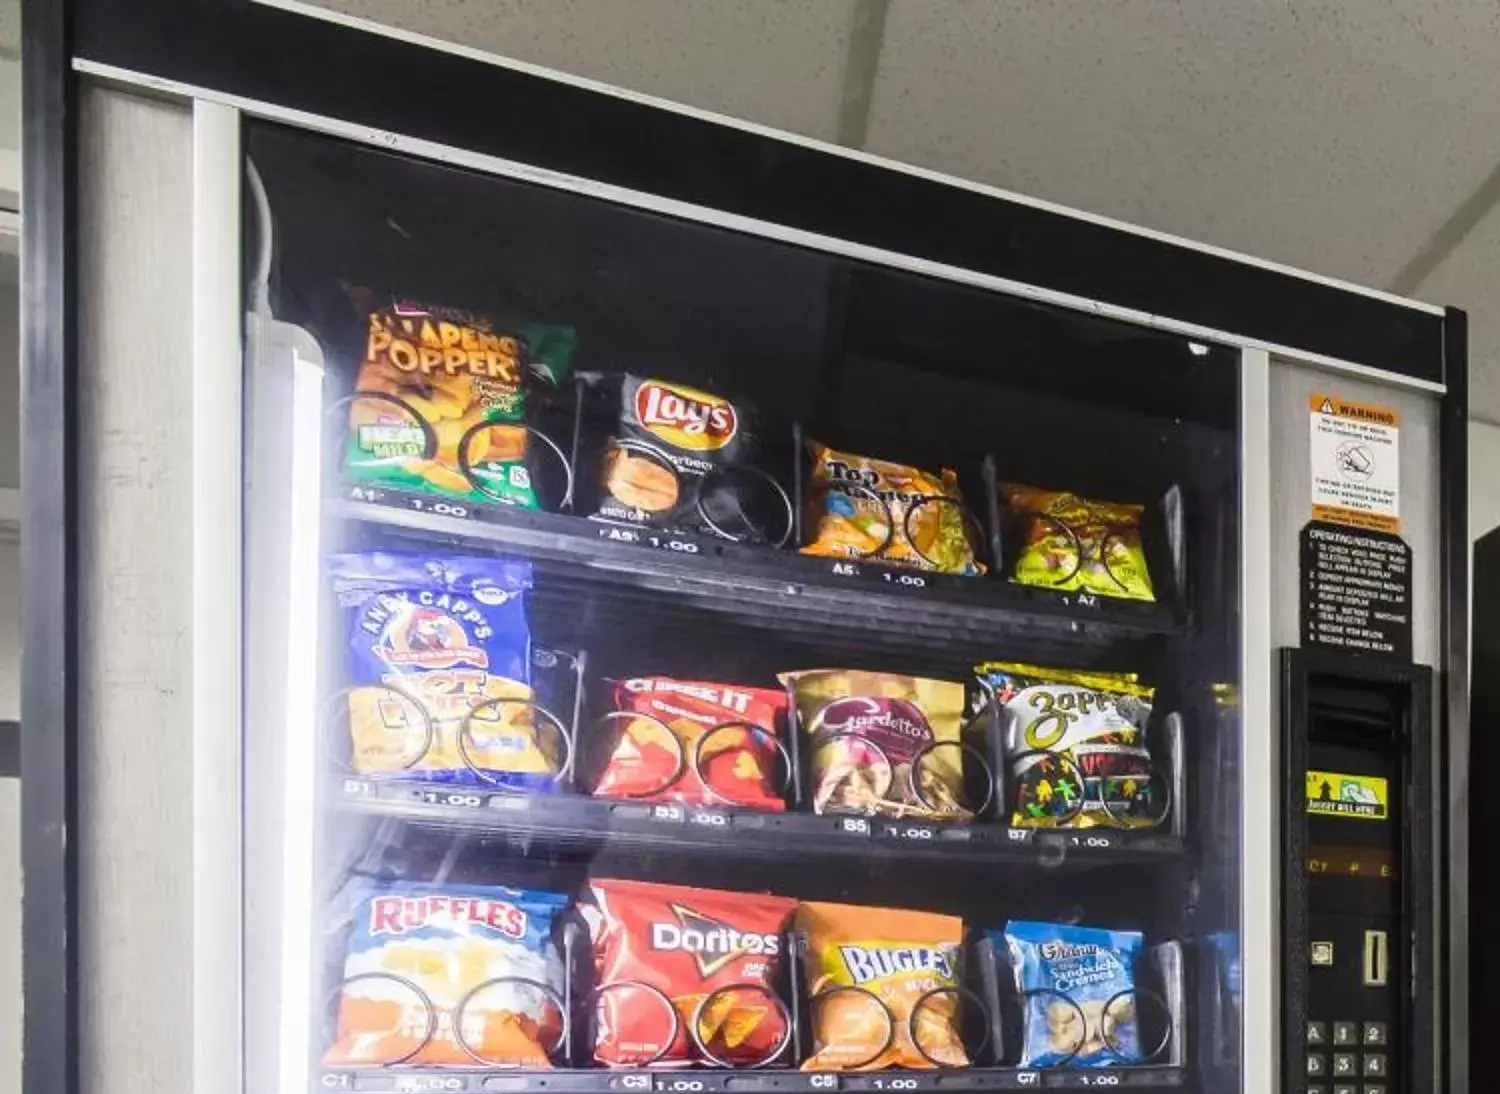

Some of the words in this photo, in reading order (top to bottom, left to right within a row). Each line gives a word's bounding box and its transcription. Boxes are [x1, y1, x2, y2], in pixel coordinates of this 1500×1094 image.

[644, 387, 729, 434] Lay's
[1339, 405, 1394, 424] WARNING
[827, 461, 879, 490] Top
[411, 499, 467, 519] 1.00
[650, 537, 699, 554] 1.00
[883, 573, 926, 588] 1.00
[424, 792, 482, 809] 1.00
[886, 827, 933, 840] 1.00
[1072, 836, 1110, 849] 1.00
[370, 895, 528, 940] RUFFLES
[652, 923, 780, 956] Doritos
[1307, 1026, 1321, 1041] A
[1339, 1026, 1348, 1041] 1
[1368, 1026, 1380, 1042] 2
[1307, 1057, 1320, 1072] B
[1338, 1057, 1349, 1072] 3
[622, 1076, 648, 1089] C3
[655, 1080, 704, 1092] 1.00
[873, 1080, 919, 1090] 1.00
[1080, 1075, 1120, 1086] 1.00
